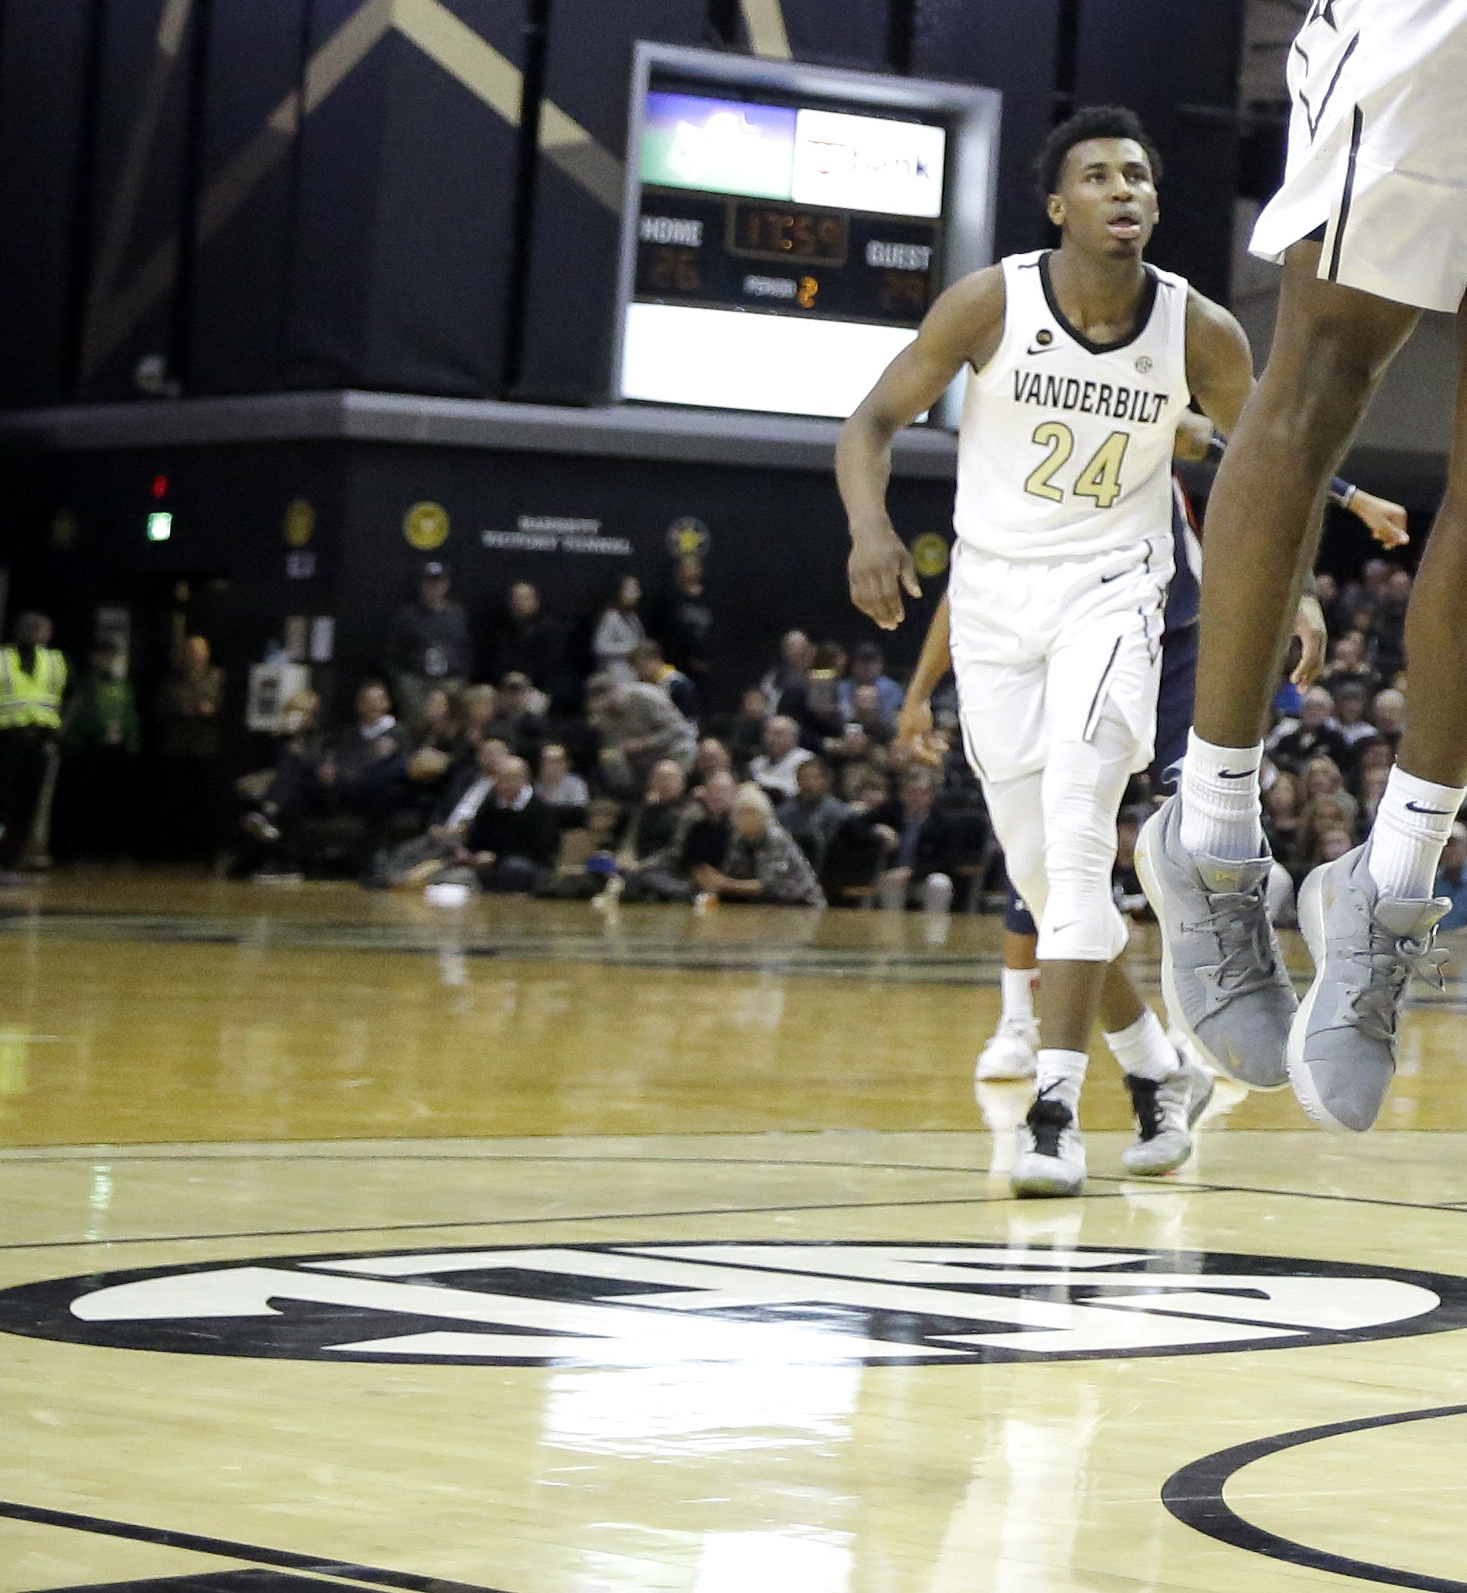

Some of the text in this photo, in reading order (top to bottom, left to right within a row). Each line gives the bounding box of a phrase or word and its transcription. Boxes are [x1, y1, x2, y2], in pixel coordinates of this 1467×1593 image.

[640, 216, 932, 270] HOME GUEST
[1013, 370, 1169, 424] VANDERBILT
[1024, 421, 1130, 508] 24
